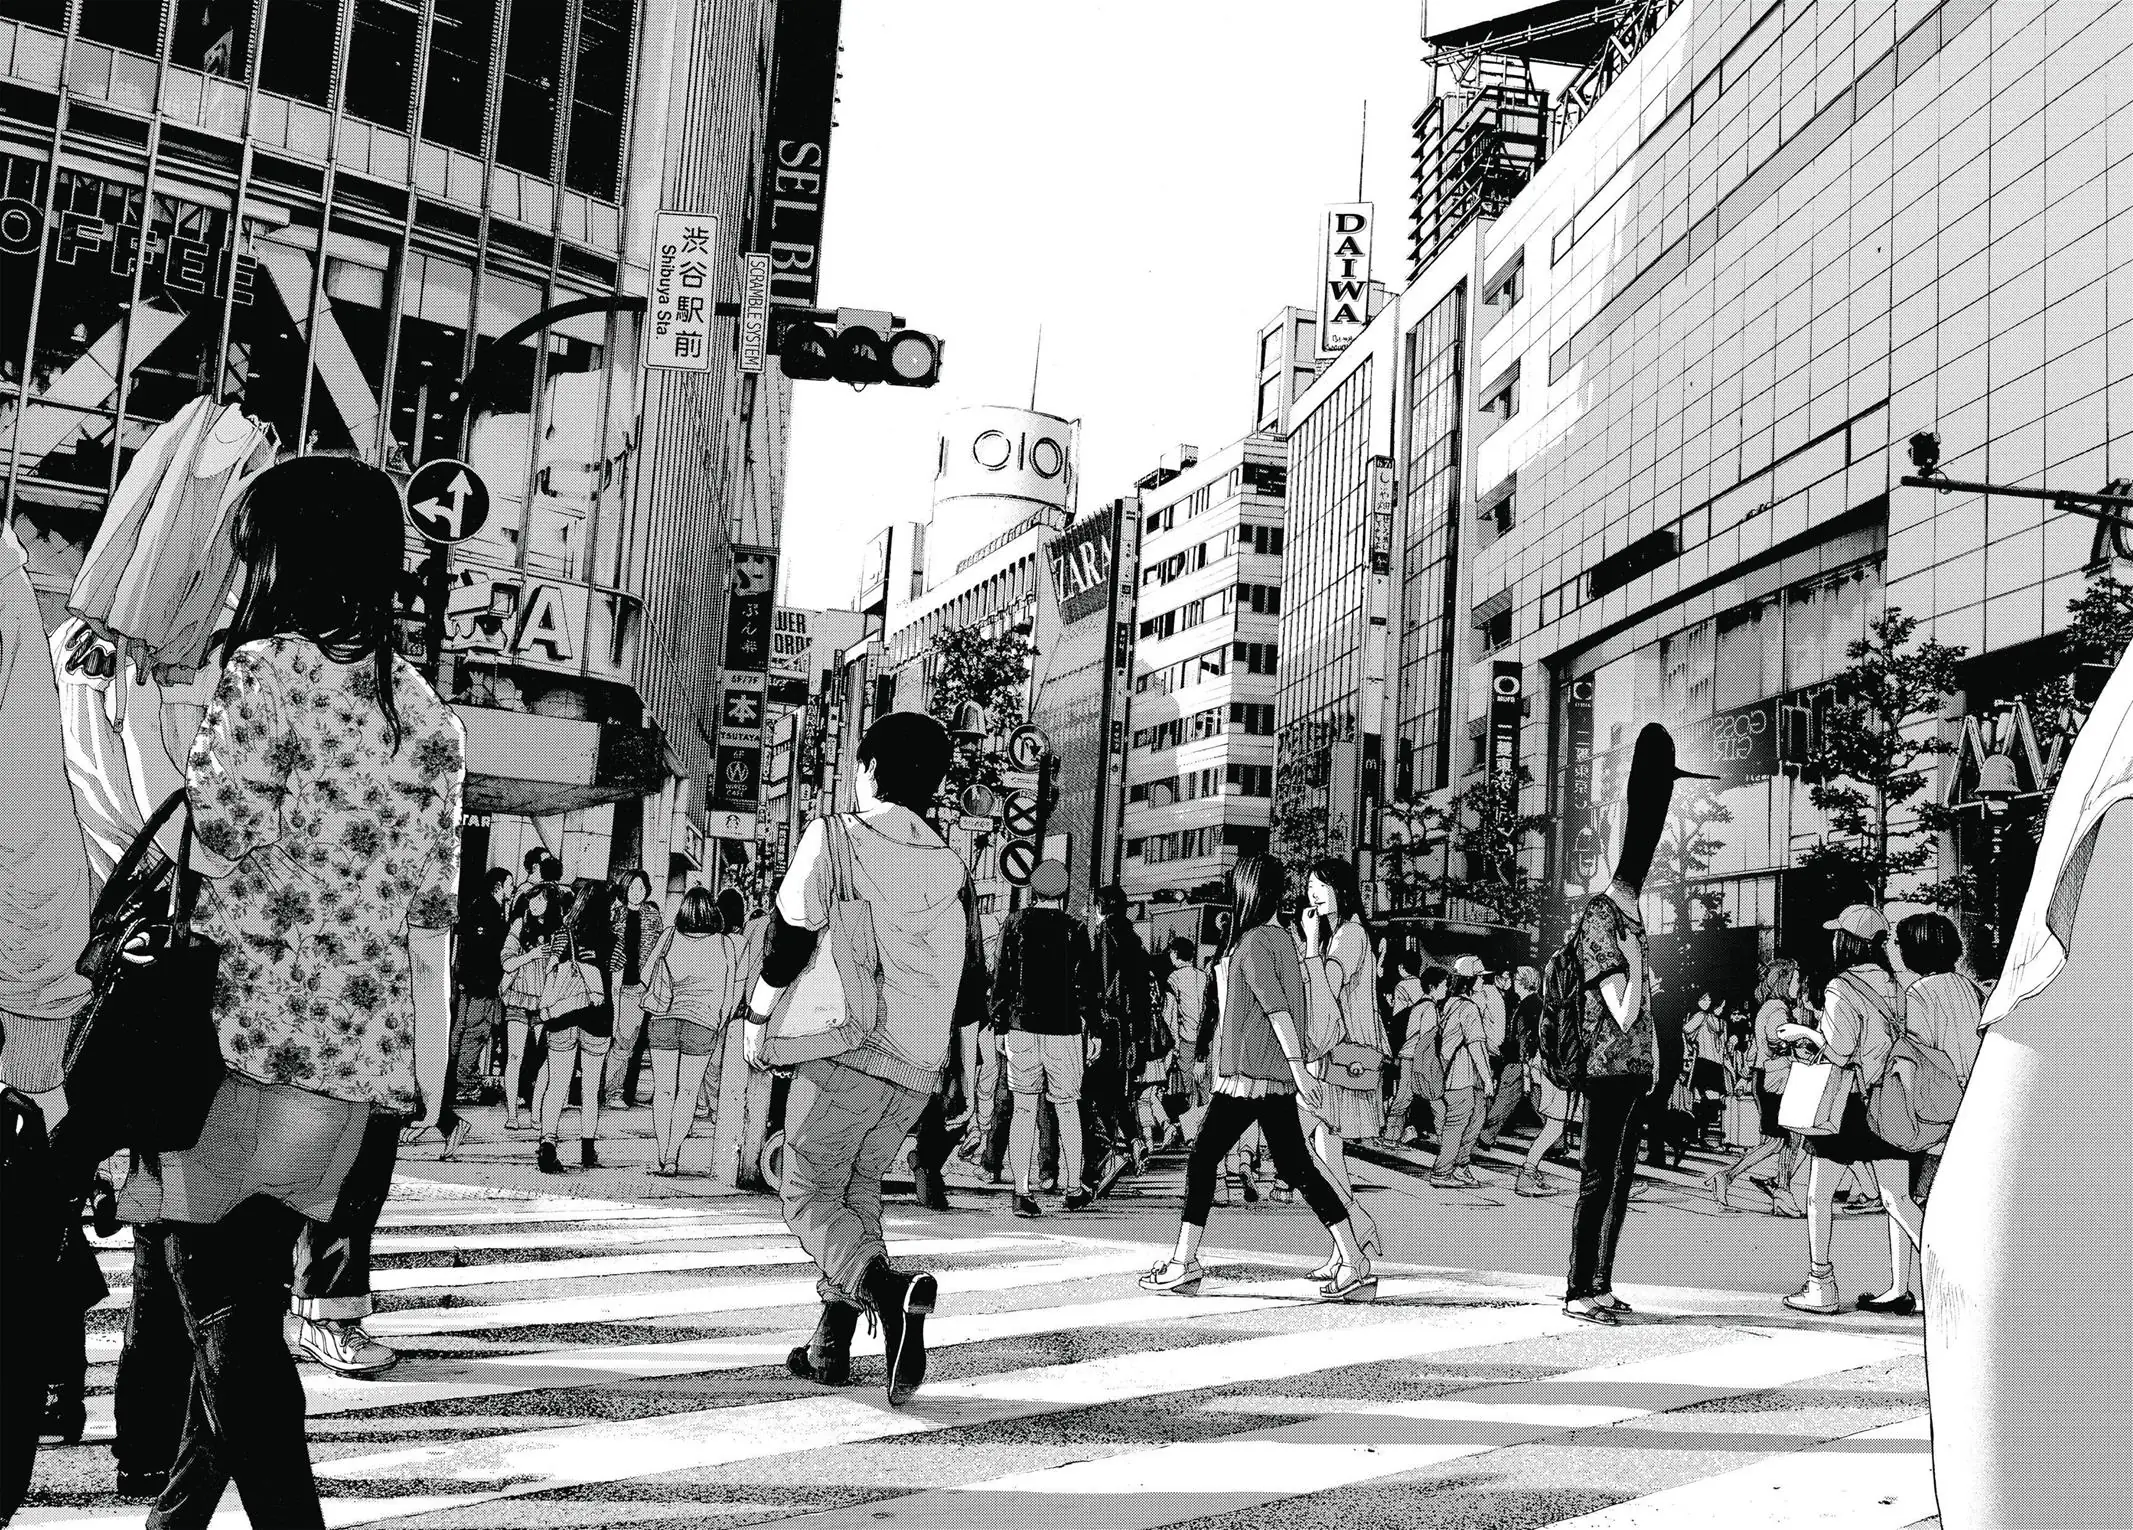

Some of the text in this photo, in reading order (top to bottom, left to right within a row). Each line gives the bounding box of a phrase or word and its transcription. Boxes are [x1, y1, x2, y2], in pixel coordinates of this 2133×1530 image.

[655, 244, 677, 340] Shibuya Sta.
[675, 226, 711, 359] 渋谷駅前
[744, 260, 766, 366] SCRAMBLE SYSTEM
[1328, 213, 1368, 325] DAIWA
[720, 731, 760, 742] TSUTAYA
[727, 693, 758, 723] 本
